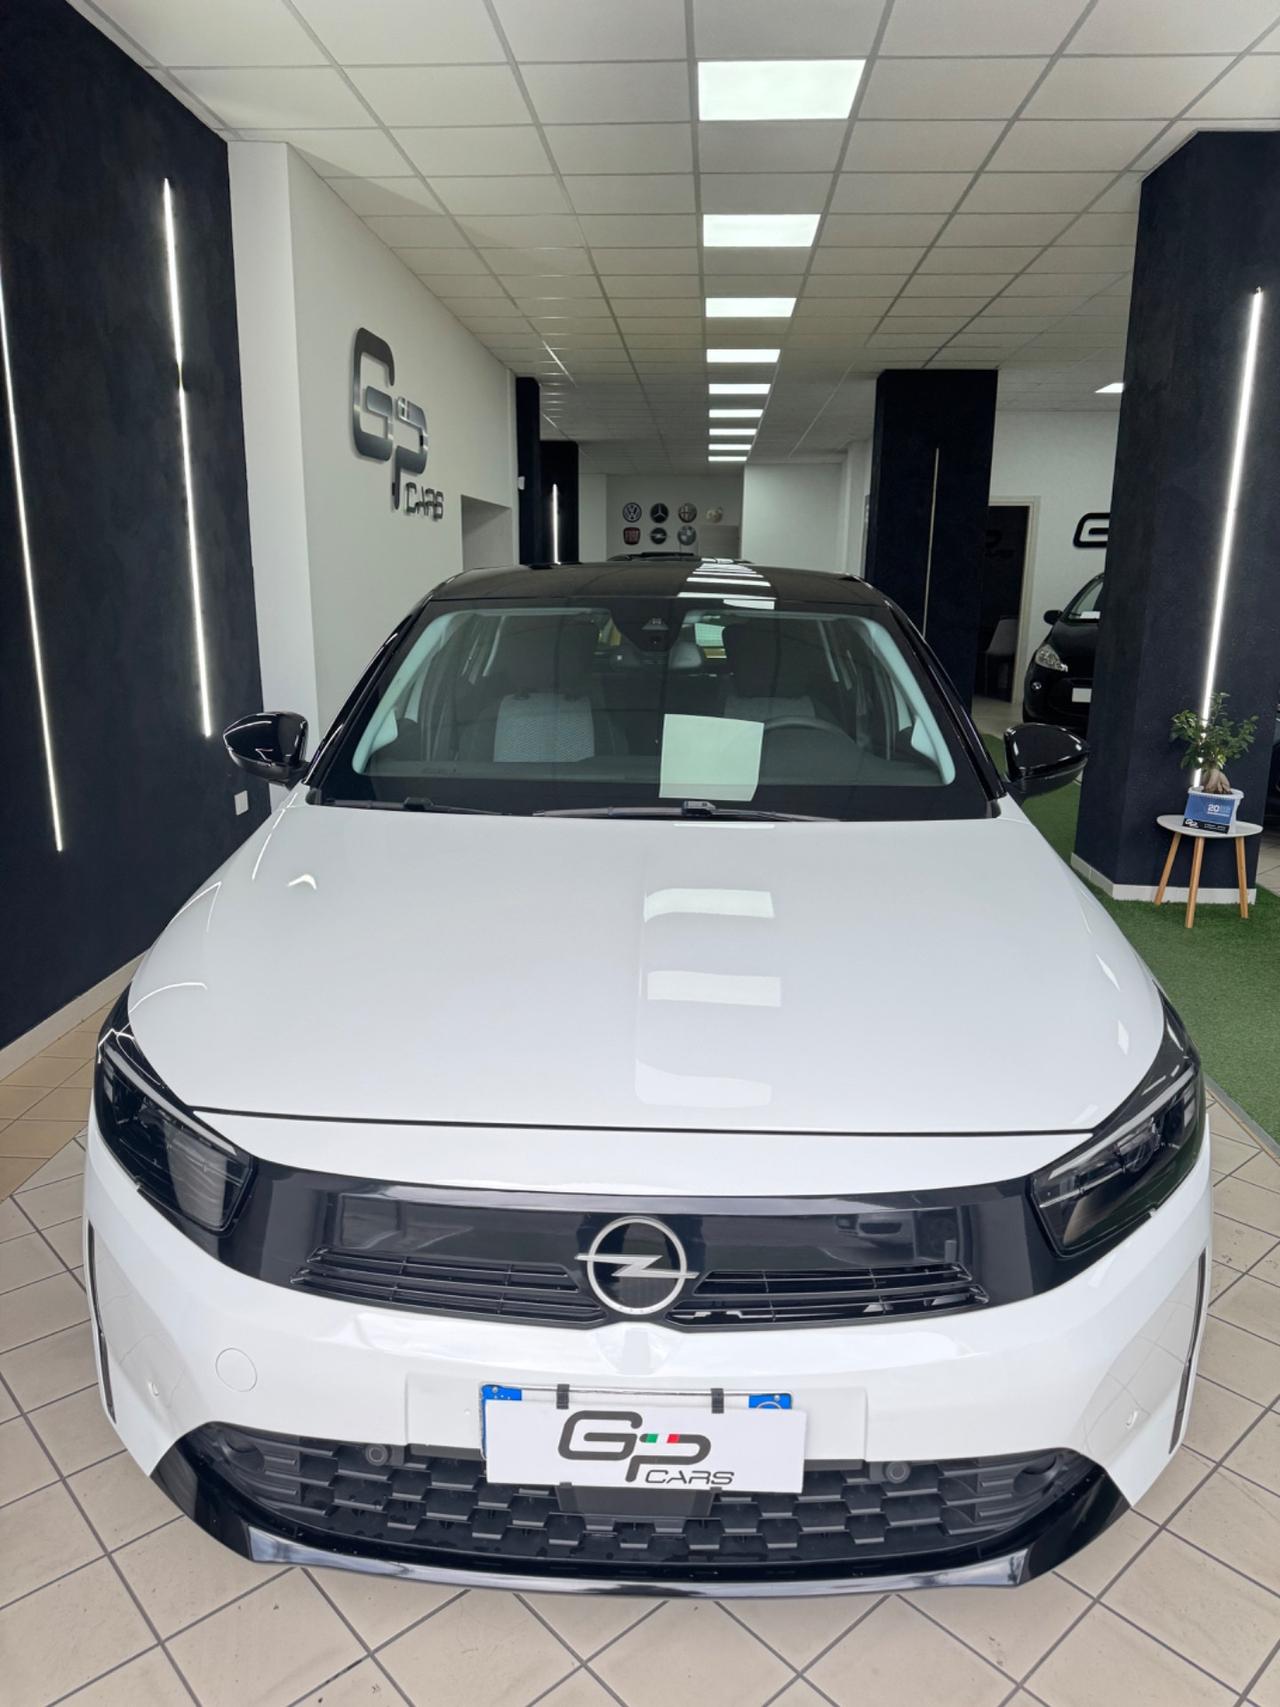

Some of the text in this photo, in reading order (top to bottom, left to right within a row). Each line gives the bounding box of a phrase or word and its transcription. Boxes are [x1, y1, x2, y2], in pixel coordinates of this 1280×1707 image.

[405, 481, 444, 519] CARS
[558, 1410, 711, 1482] GP
[645, 1469, 734, 1485] CARS
